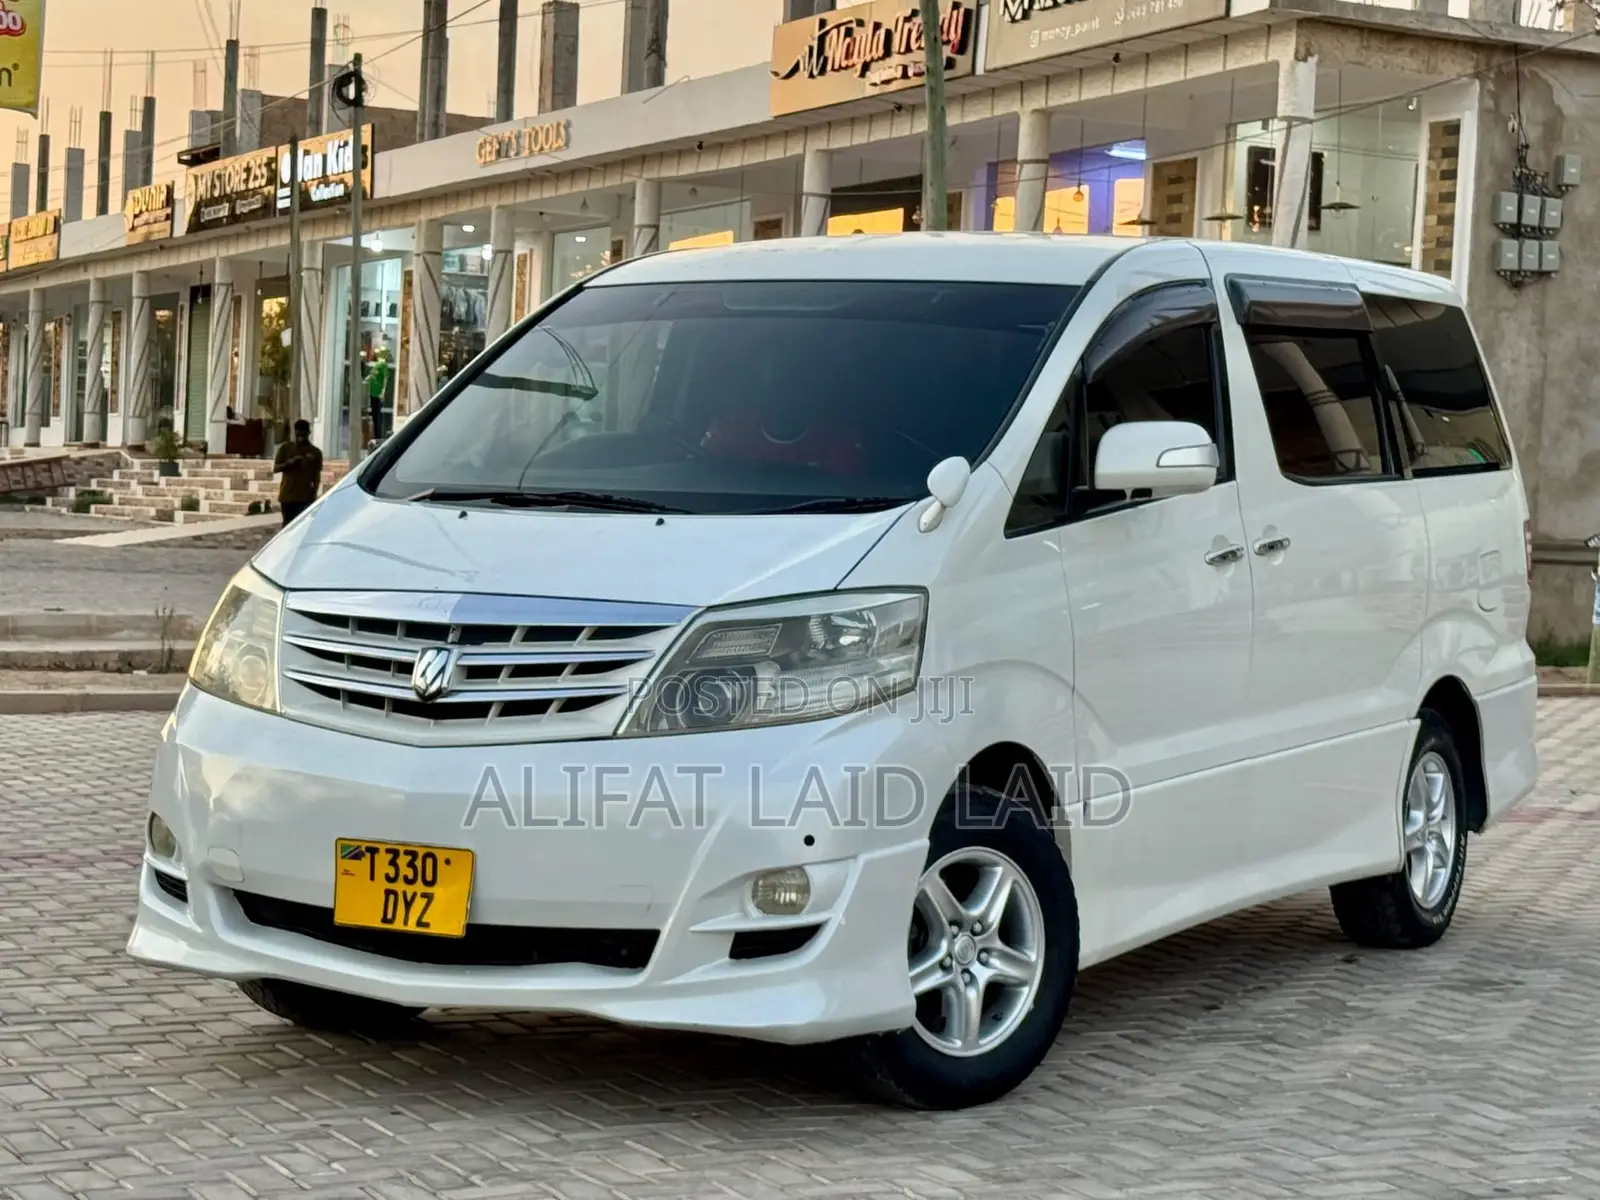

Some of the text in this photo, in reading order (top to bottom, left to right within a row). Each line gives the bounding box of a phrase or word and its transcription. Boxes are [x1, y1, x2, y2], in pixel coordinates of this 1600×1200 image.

[894, 1, 967, 54] Tredy
[326, 133, 360, 177] Kid
[523, 119, 567, 157] TOOLS
[213, 161, 247, 198] STORE
[247, 156, 267, 191] 255
[381, 889, 434, 928] DYZ
